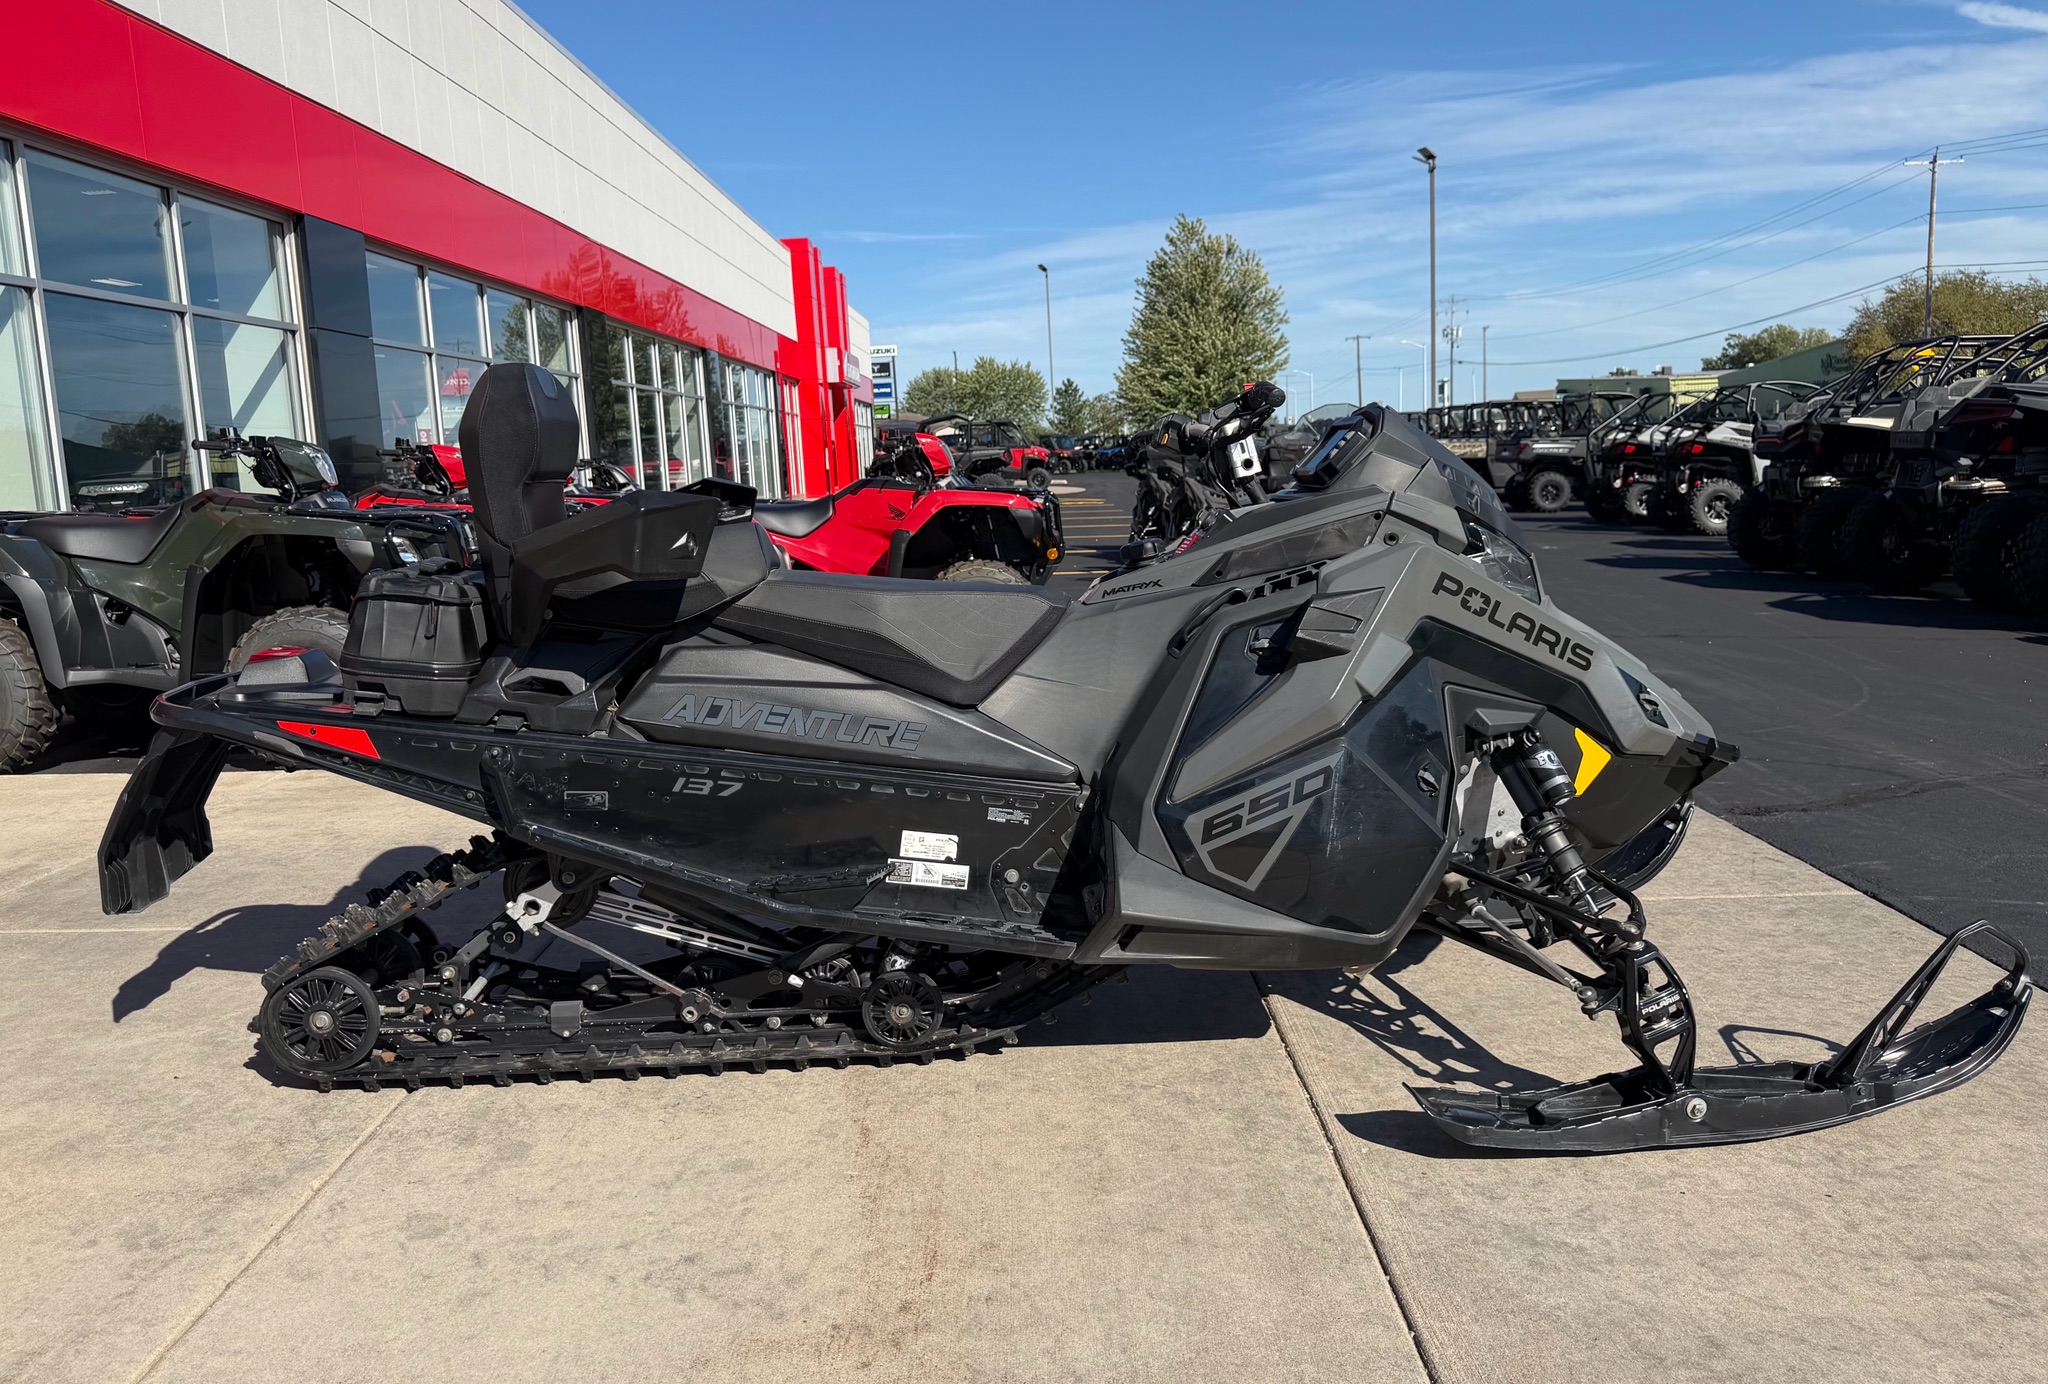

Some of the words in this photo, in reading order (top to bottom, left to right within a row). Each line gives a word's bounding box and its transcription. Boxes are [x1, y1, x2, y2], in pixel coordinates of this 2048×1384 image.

[1102, 579, 1163, 598] MATRYX
[1431, 571, 1594, 671] POLARIS
[661, 693, 928, 751] ADVENTURE
[672, 777, 744, 797] 137
[1200, 764, 1335, 846] 650
[1641, 994, 1681, 1015] POLARIS
